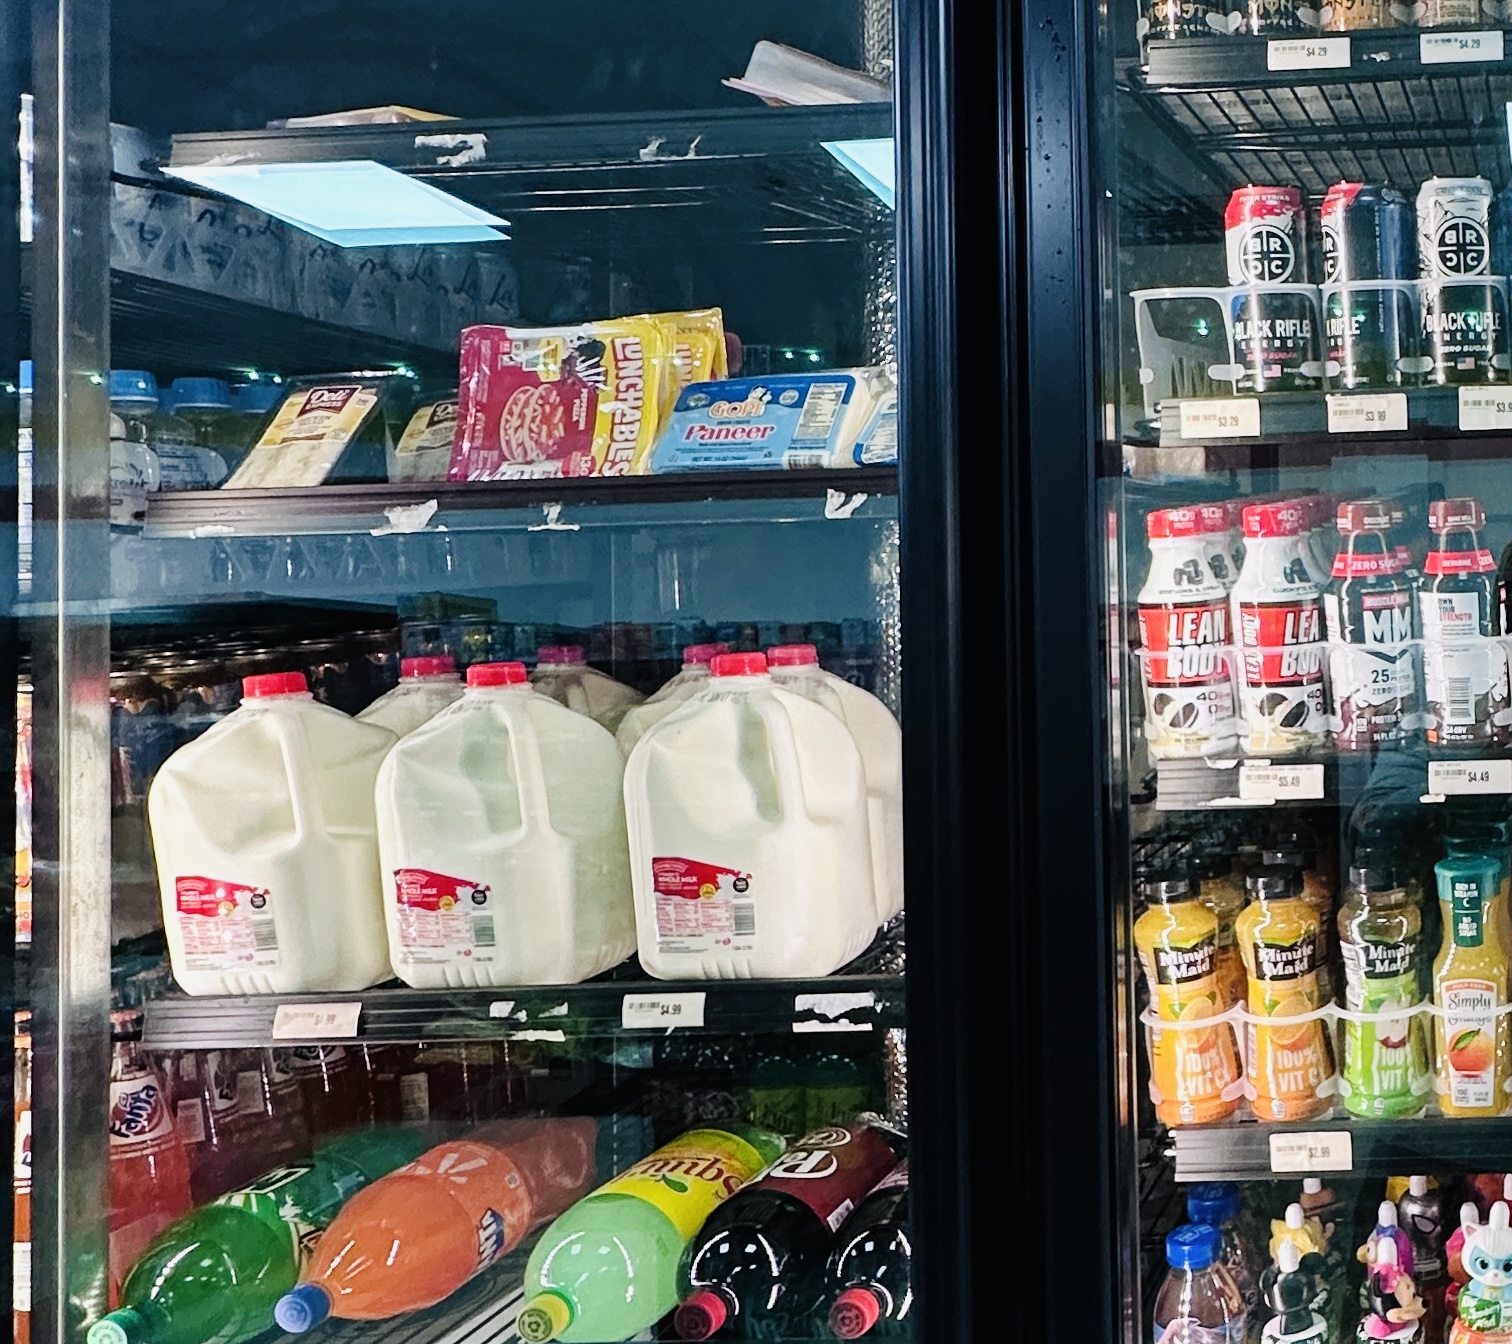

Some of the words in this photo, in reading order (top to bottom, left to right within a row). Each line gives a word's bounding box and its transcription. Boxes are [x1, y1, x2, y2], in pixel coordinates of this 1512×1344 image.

[1305, 46, 1328, 57] $4.29
[1458, 38, 1481, 50] $4.29
[1236, 319, 1273, 340] BLACK
[1275, 319, 1312, 339] RIFLE
[1426, 312, 1465, 333] BLACK
[310, 387, 350, 403] Deli
[601, 336, 645, 476] LUNCHABLES
[708, 399, 766, 418] GOPI
[1364, 409, 1387, 422] $3.99
[684, 423, 775, 442] Paneer
[1350, 559, 1376, 571] ZERO
[1167, 608, 1227, 646] LEAN
[1371, 669, 1390, 684] 25
[1462, 897, 1470, 908] C
[1159, 944, 1215, 968] Minute
[1258, 944, 1314, 968] Minute
[1368, 941, 1416, 961] Minute
[1171, 960, 1210, 978] Maid
[1267, 958, 1309, 977] Maid
[1373, 955, 1410, 974] Maid
[660, 1004, 682, 1016] $4.99
[1447, 991, 1491, 1012] Simply
[1276, 1049, 1318, 1069] 100%
[1187, 1072, 1213, 1097] VIT
[1278, 1071, 1302, 1093] VIT
[1381, 1071, 1403, 1091] VIT
[1308, 1145, 1331, 1159] $2.99
